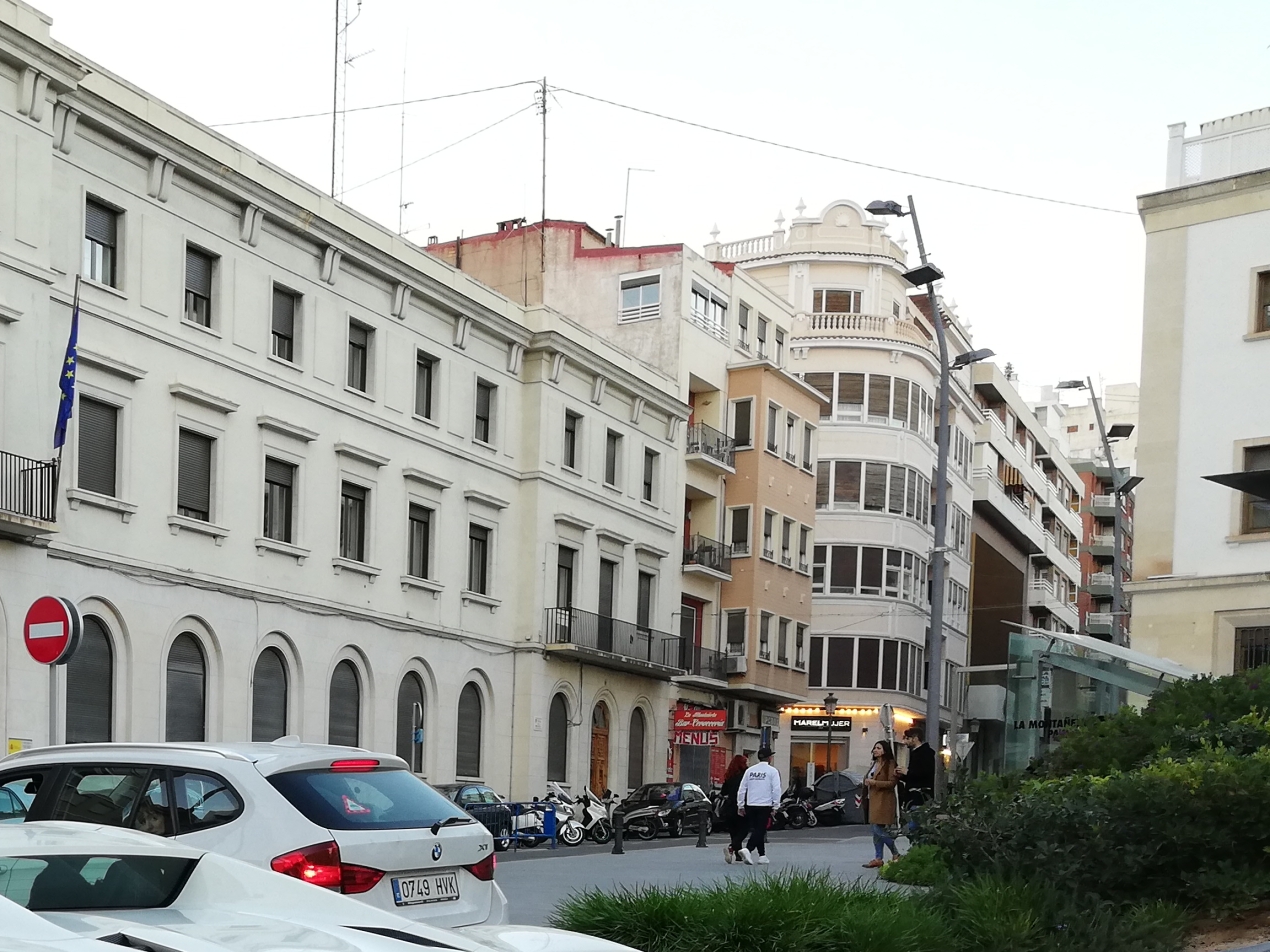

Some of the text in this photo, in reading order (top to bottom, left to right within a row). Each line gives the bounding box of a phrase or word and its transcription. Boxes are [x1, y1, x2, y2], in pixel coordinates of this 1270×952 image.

[1014, 720, 1025, 730] LA
[749, 771, 767, 779] PARIS
[401, 876, 457, 898] 0749 HVK
